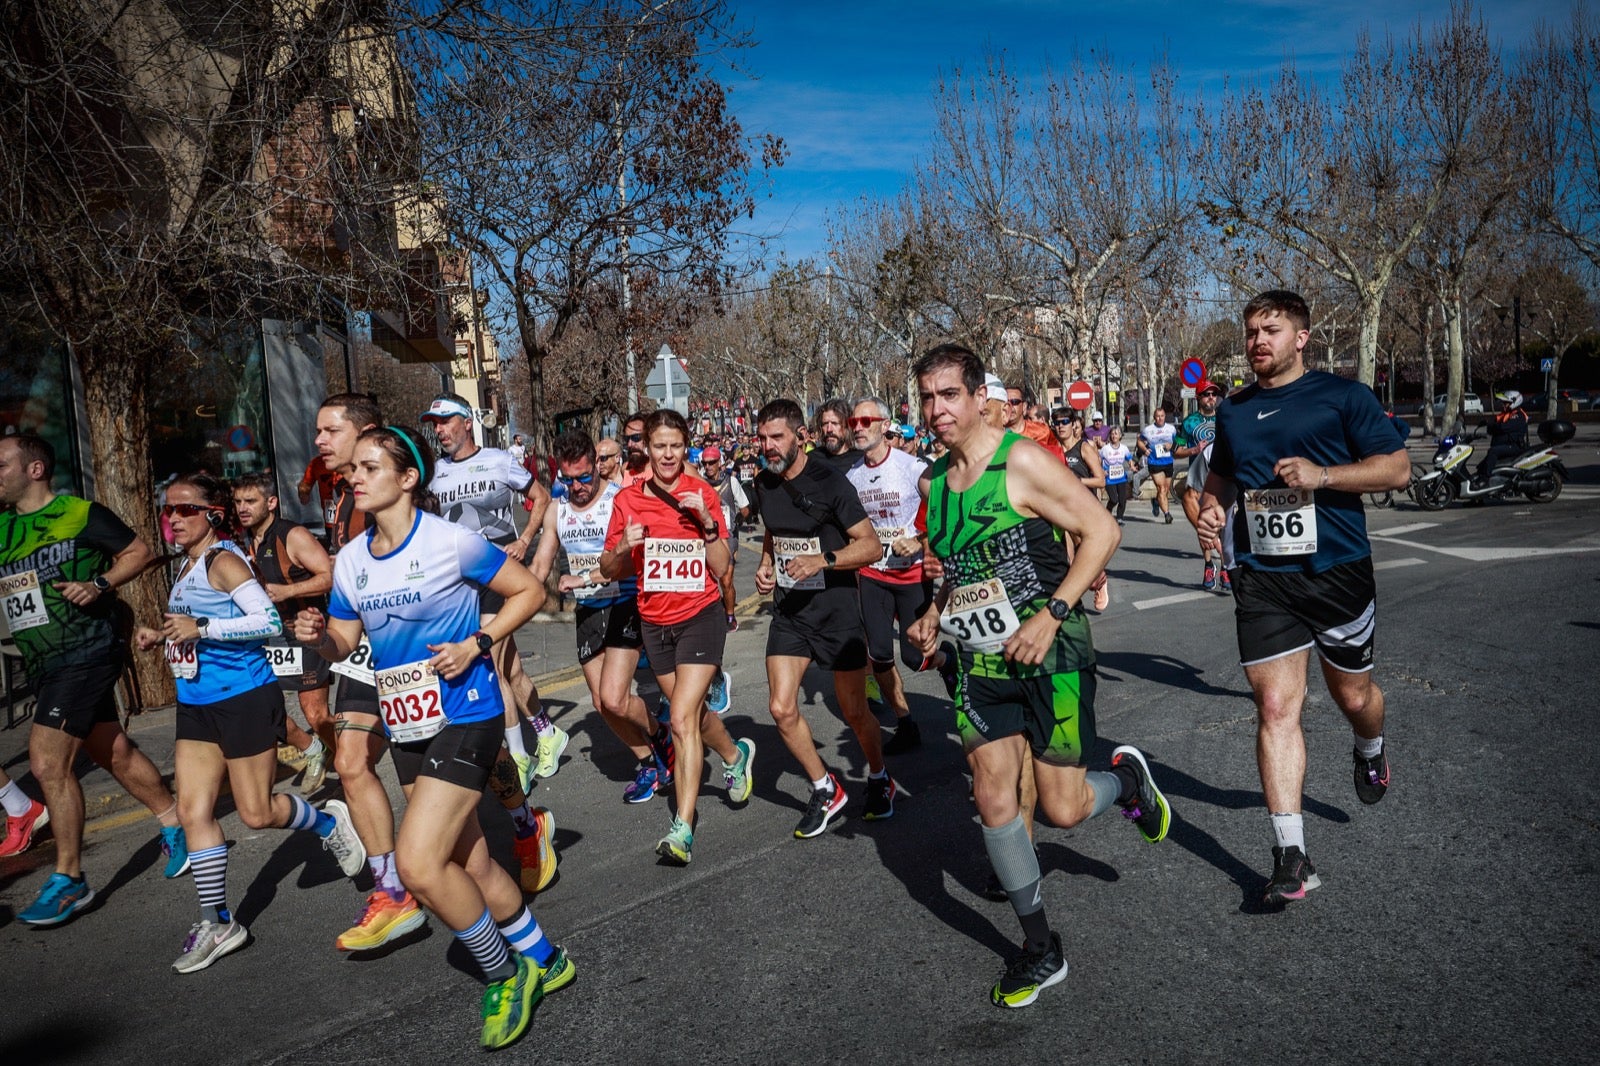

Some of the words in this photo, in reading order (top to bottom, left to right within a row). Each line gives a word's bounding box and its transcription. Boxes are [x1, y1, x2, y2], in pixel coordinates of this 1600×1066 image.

[561, 527, 605, 540] MARACENA
[876, 530, 899, 538] ONDO
[1254, 512, 1304, 539] 366
[658, 543, 694, 553] FONDO
[647, 559, 703, 579] 2140
[7, 592, 36, 619] 634
[357, 591, 422, 613] MARACENA
[949, 607, 1006, 641] 318
[265, 648, 296, 665] 284
[379, 670, 423, 689] FONDO
[381, 690, 441, 726] 2032
